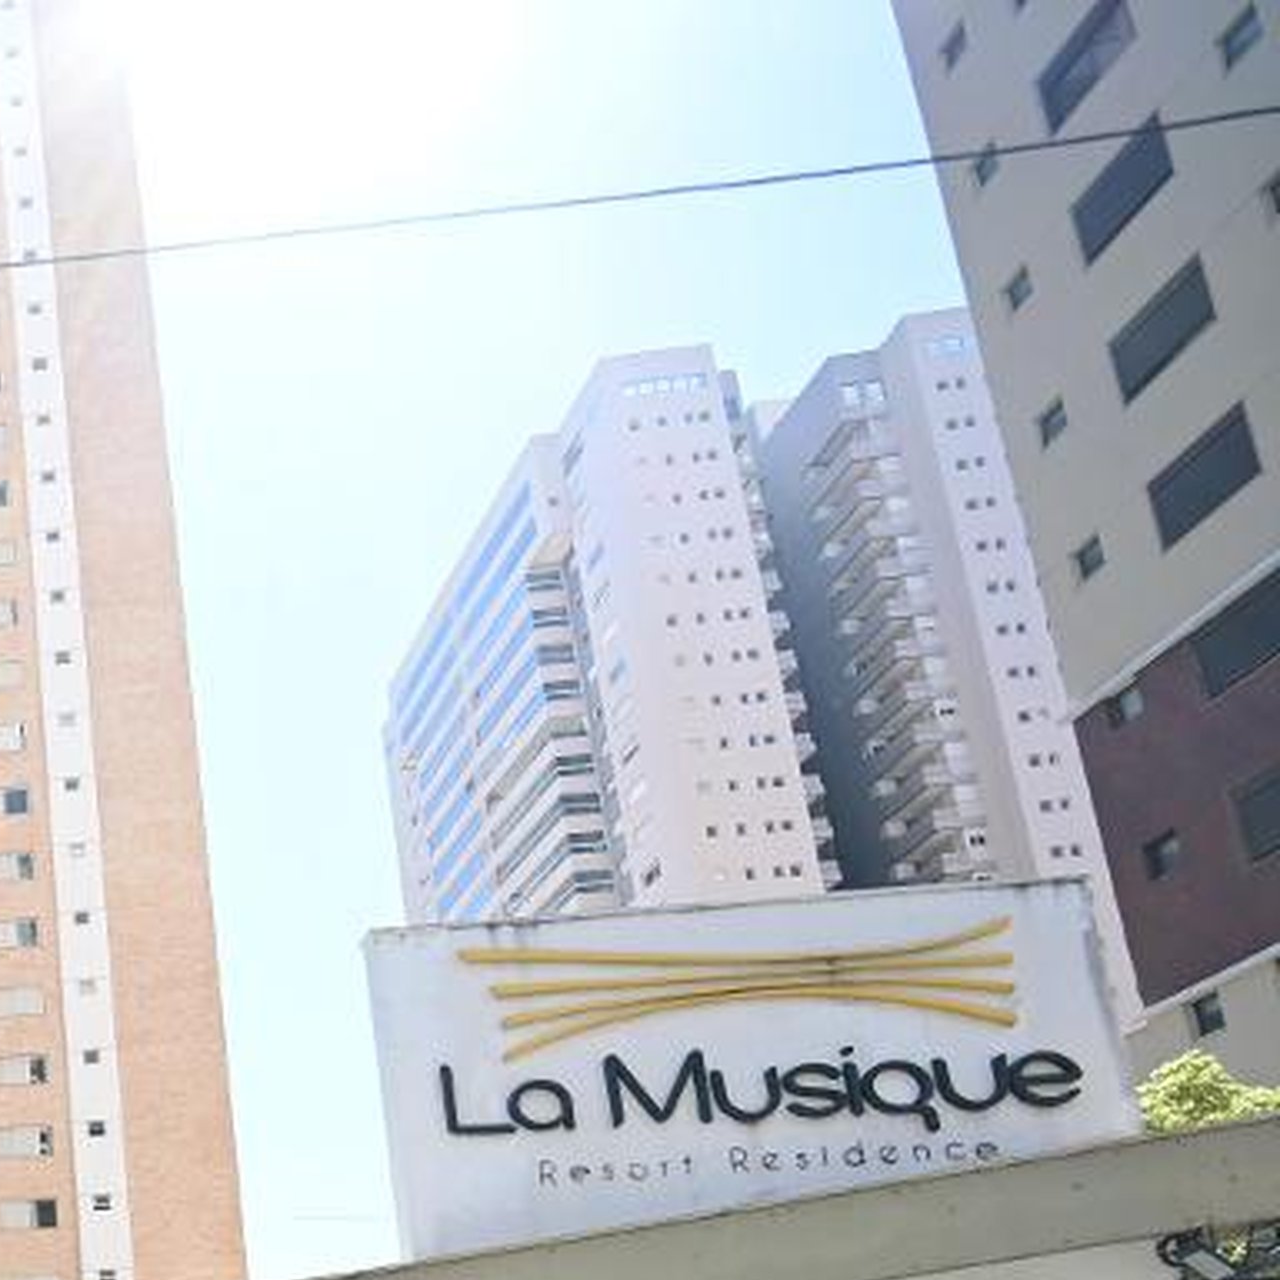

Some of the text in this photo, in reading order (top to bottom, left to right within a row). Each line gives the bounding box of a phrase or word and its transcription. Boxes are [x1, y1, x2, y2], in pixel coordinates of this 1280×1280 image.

[439, 1044, 1085, 1136] La Musique
[538, 1138, 1001, 1187] Resort Residence
